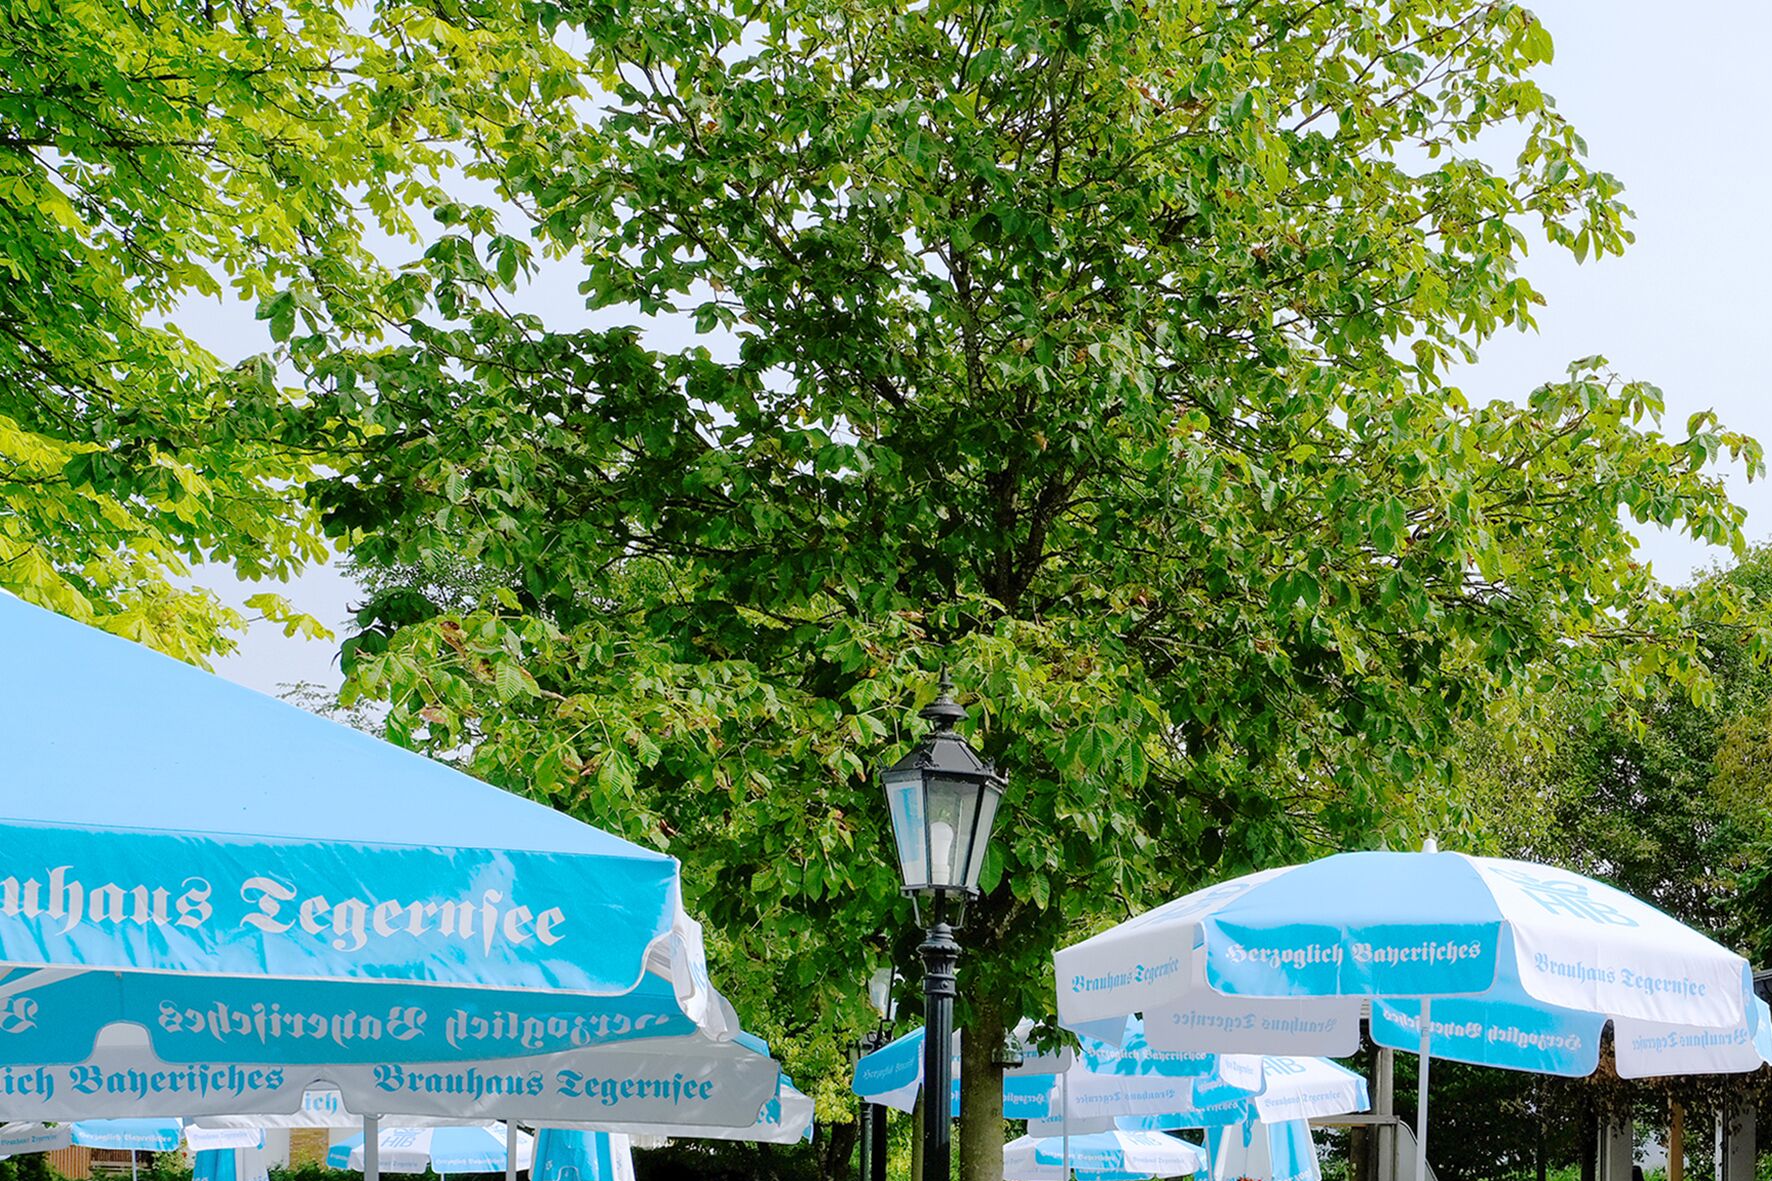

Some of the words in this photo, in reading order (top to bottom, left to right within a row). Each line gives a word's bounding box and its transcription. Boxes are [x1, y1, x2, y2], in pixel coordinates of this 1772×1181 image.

[1225, 944, 1343, 969] Herzoglich
[1534, 952, 1616, 985] Brauhaus
[1071, 971, 1133, 993] Brauhaus
[373, 1064, 544, 1100] Brauhaus
